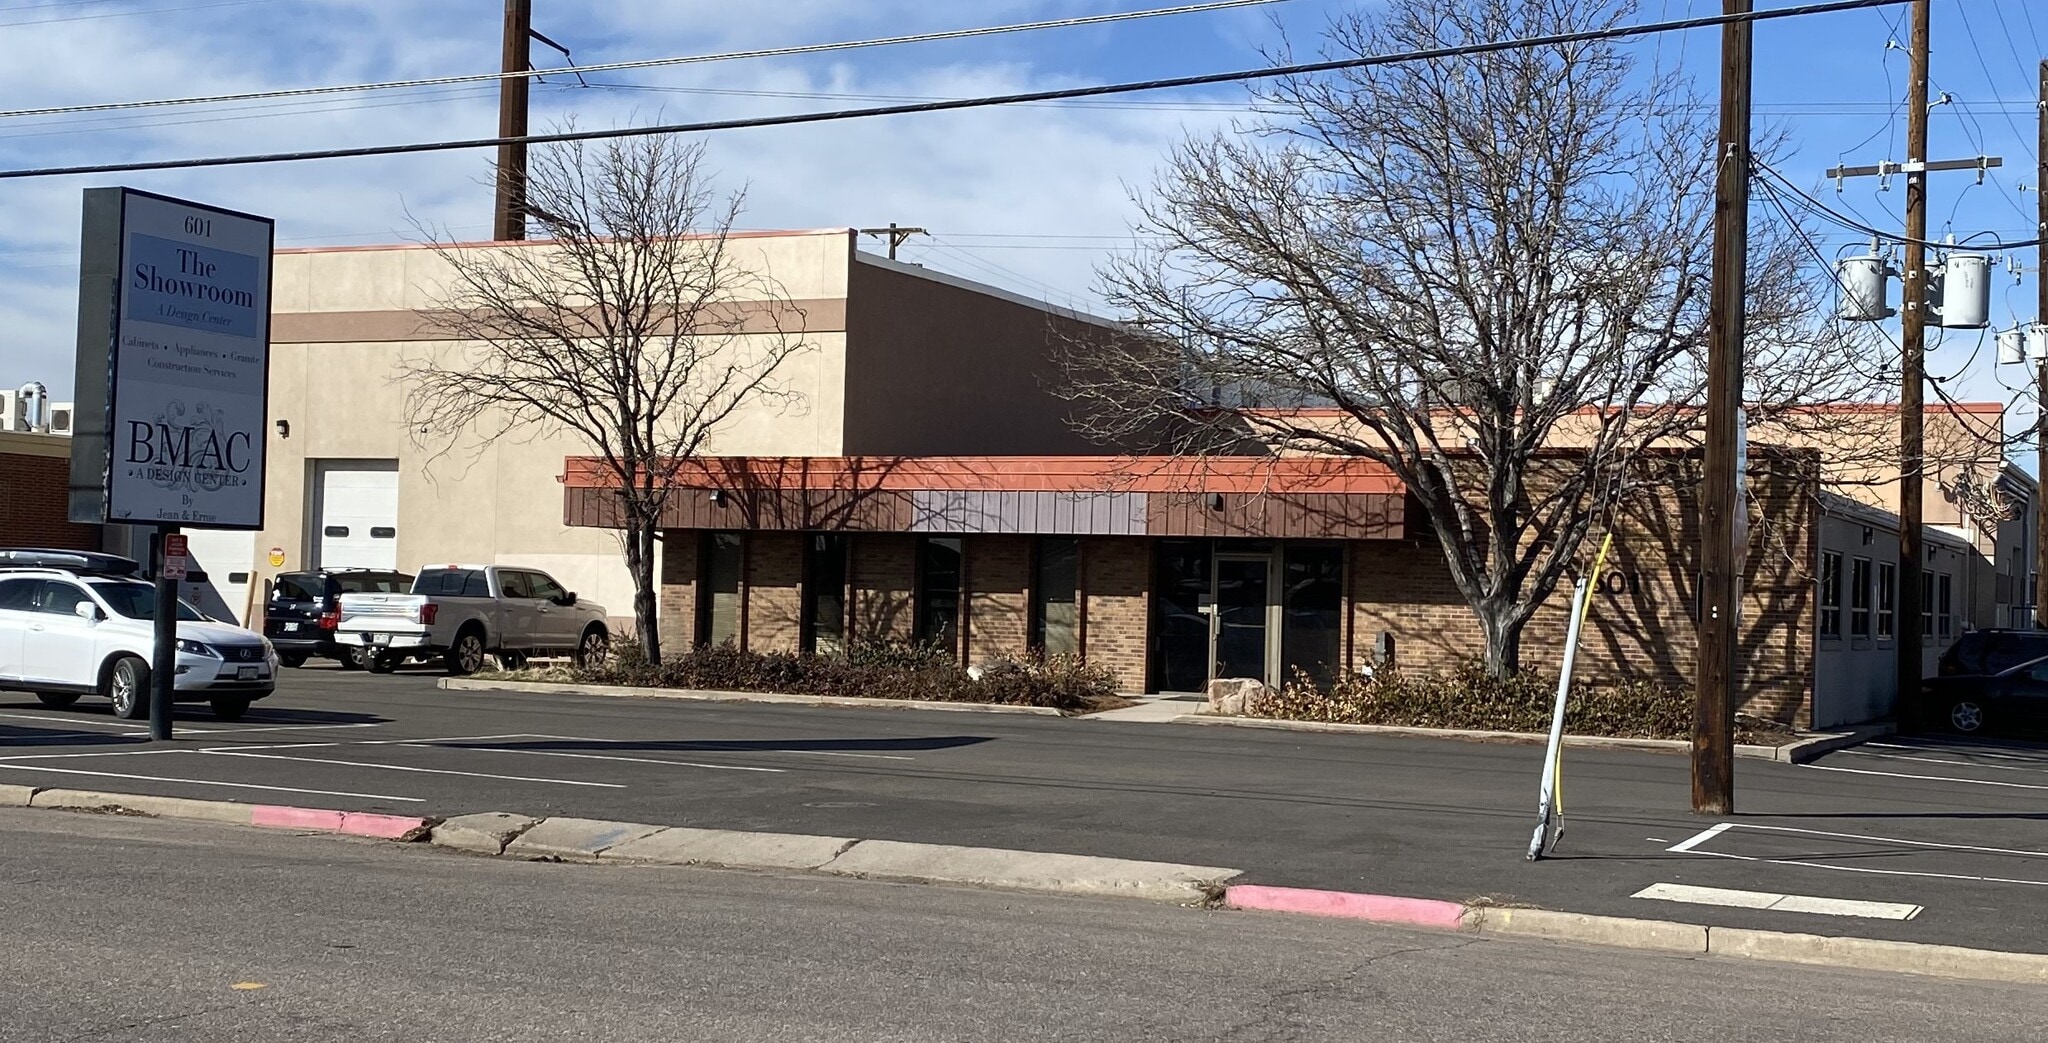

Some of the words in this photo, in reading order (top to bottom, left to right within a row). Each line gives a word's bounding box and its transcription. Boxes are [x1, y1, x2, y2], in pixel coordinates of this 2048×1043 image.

[184, 215, 211, 237] 601
[176, 248, 216, 279] The
[134, 262, 253, 308] Showroom
[156, 303, 164, 316] A
[166, 305, 200, 324] Design
[202, 310, 232, 326] Center
[122, 335, 159, 350] Cabinets
[174, 342, 218, 358] Appliances
[230, 351, 260, 364] Granite
[147, 357, 201, 374] Construction
[202, 365, 236, 379] Services
[126, 420, 250, 473] BMAC
[135, 468, 144, 480] A
[146, 468, 191, 483] DESIGN
[194, 472, 239, 487] CENTER
[181, 494, 194, 507] By
[156, 508, 179, 520] Jean
[181, 510, 190, 521] &
[192, 510, 217, 522] Ernie
